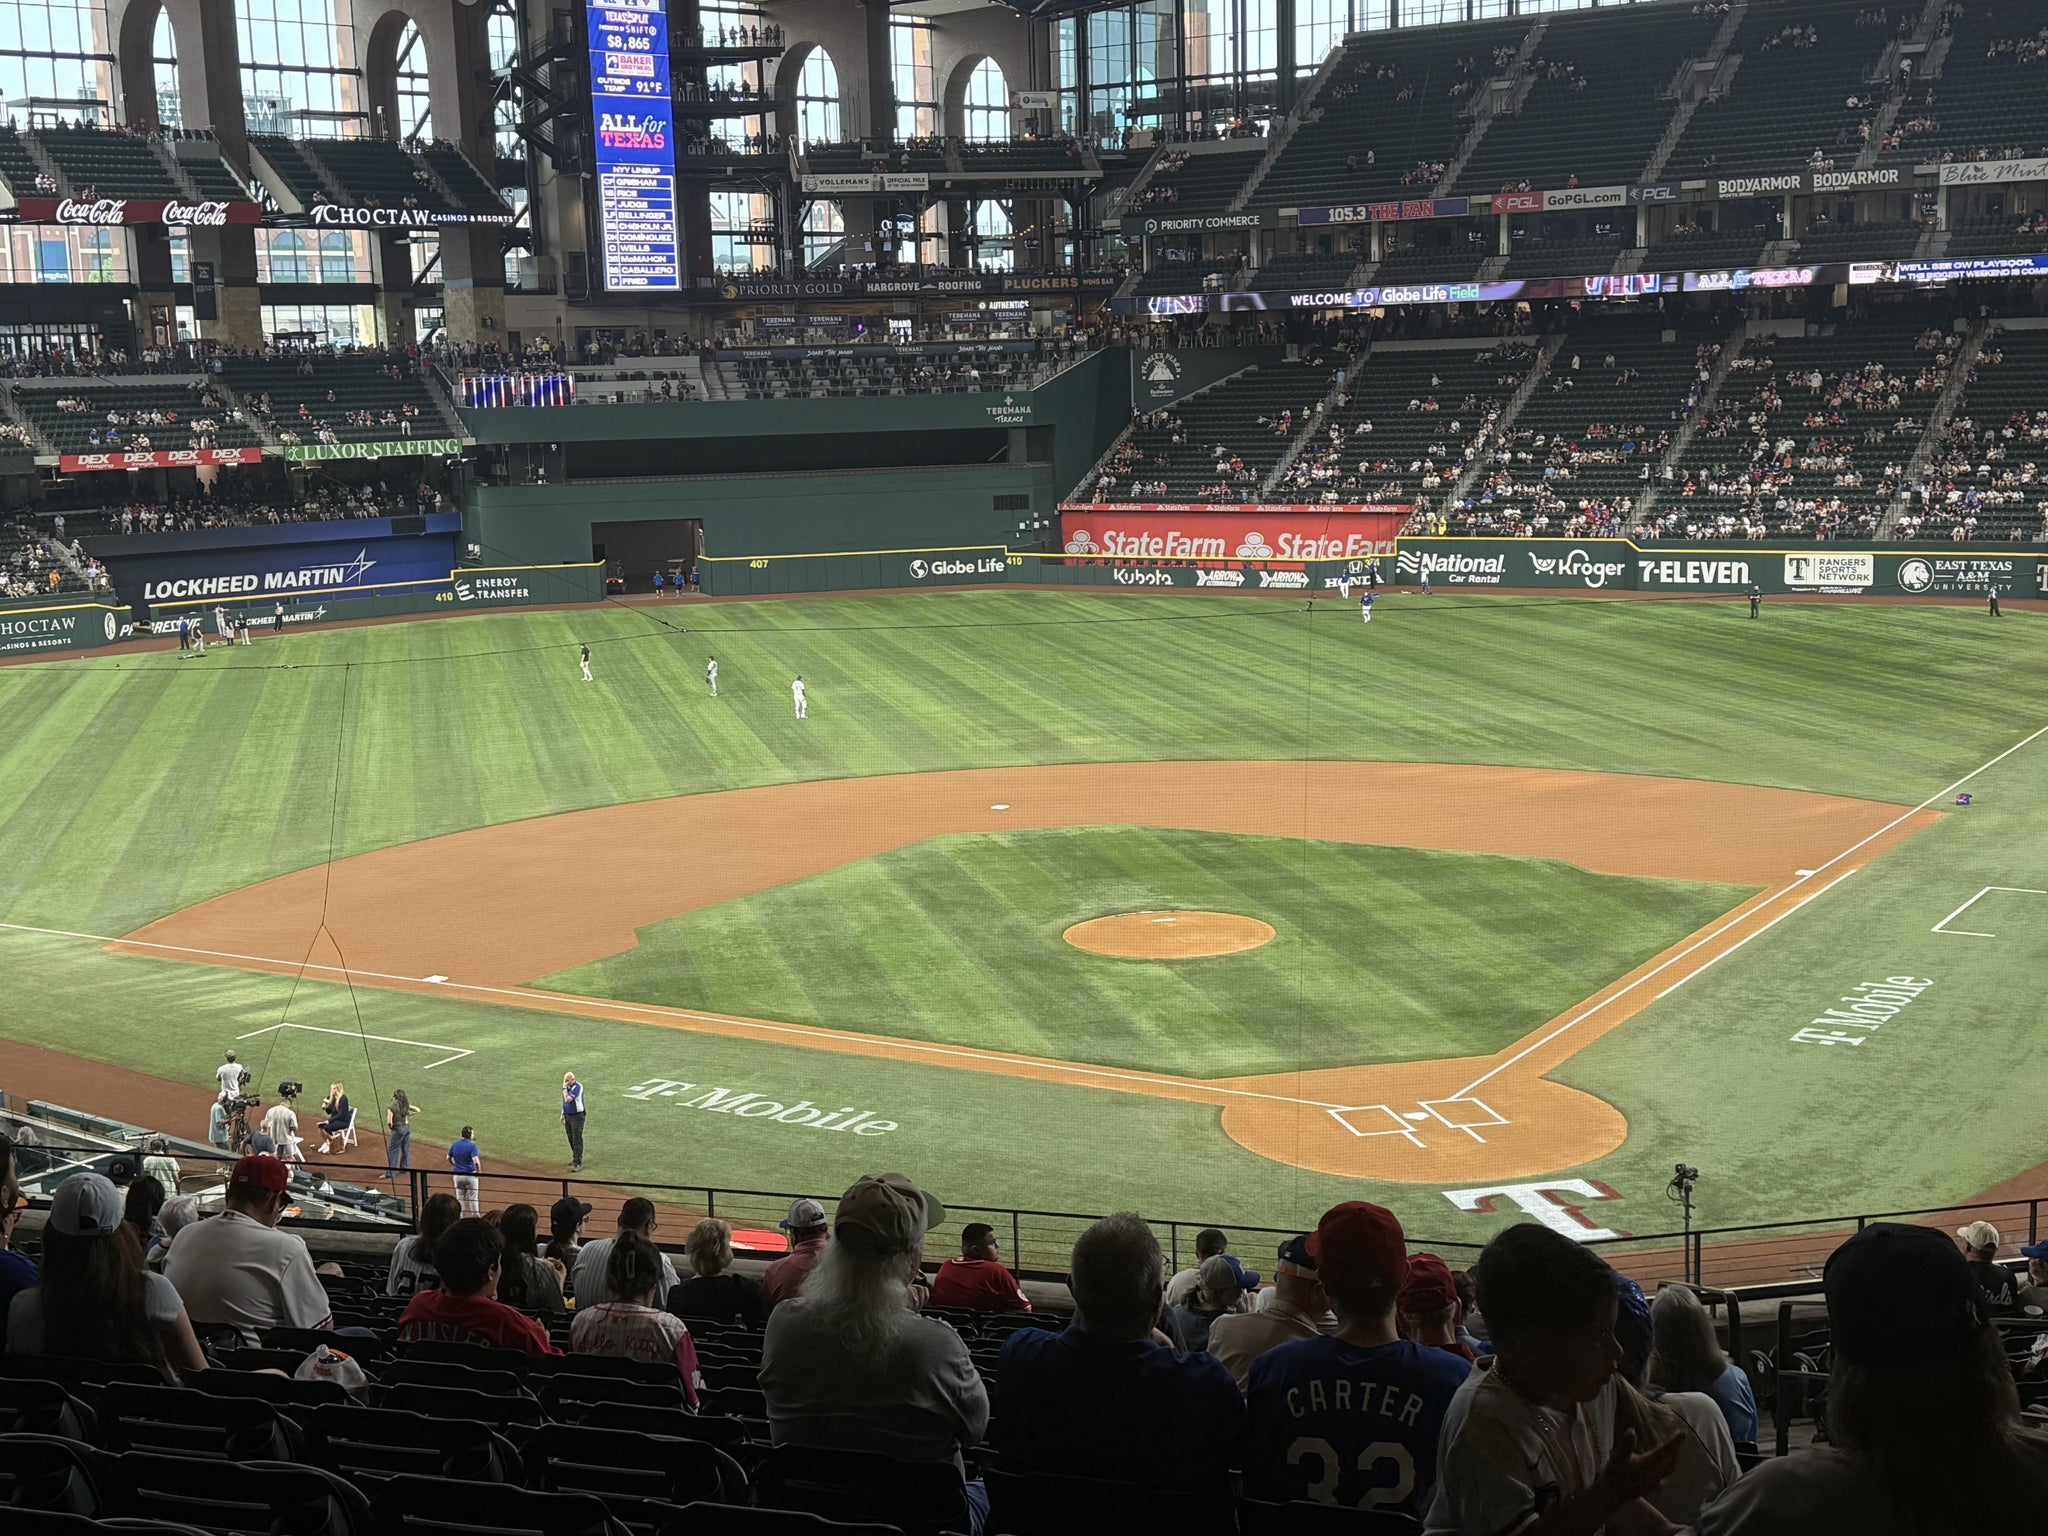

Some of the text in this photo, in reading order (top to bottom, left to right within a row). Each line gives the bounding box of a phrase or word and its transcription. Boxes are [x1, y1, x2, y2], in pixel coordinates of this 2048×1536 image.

[607, 34, 650, 50] $8,865
[620, 56, 652, 65] BAKER
[600, 113, 666, 141] ALL for
[601, 131, 665, 149] TEXAS
[1813, 169, 1899, 188] BODYARMOR
[1943, 164, 1990, 183] Blue
[1718, 175, 1800, 194] BODYARMOR
[1548, 192, 1621, 207] GoPGL.com
[1642, 187, 1677, 201] PGL
[1507, 197, 1539, 210] PGL
[56, 198, 127, 224] Coca-Cola
[162, 200, 229, 226] Coca-Cola
[323, 204, 514, 226] CHOCTAW CASINOS & RESORTS
[1329, 201, 1434, 222] 105.3 THE FAN
[1161, 215, 1260, 230] PRIORITY COMMERCE
[620, 245, 650, 253] WELLS
[621, 266, 673, 274] CABALLERO
[1004, 278, 1078, 289] PLUCKERS
[1698, 274, 1732, 288] ALL
[1751, 269, 1812, 286] TEXAS
[739, 283, 843, 295] PRIORITY GOLD
[867, 281, 981, 292] HARGROVE ROOFING
[1291, 284, 1479, 306] WELCOME TO Globe Life Field
[986, 406, 1032, 415] TEREMANA
[168, 450, 200, 461] DEX
[212, 448, 242, 459] DEX
[304, 438, 459, 461] LUXOR STAFFING
[78, 454, 111, 465] DEX
[124, 452, 156, 463] DEX
[750, 560, 769, 569] 407
[931, 558, 1005, 575] Globe Life
[1007, 557, 1022, 566] 410
[1936, 560, 2013, 571] EAST TEXAS
[1558, 549, 1625, 588] Kroger
[1114, 568, 1174, 586] Kubota
[1209, 570, 1237, 581] ARROW
[1272, 571, 1302, 582] ARROW
[1449, 574, 1500, 583] Car Rental
[1819, 573, 1870, 581] NETWORK
[1957, 571, 1990, 582] A&M
[144, 567, 345, 600] LOCKHEED MARTIN
[475, 578, 518, 588] ENERGY
[1934, 583, 2012, 591] UNIVERSTY
[435, 591, 453, 602] 410
[476, 588, 529, 599] TRANSFER
[38, 637, 72, 647] RESORTS
[1287, 1379, 1423, 1427] CARTER
[1287, 1436, 1416, 1509] 32
